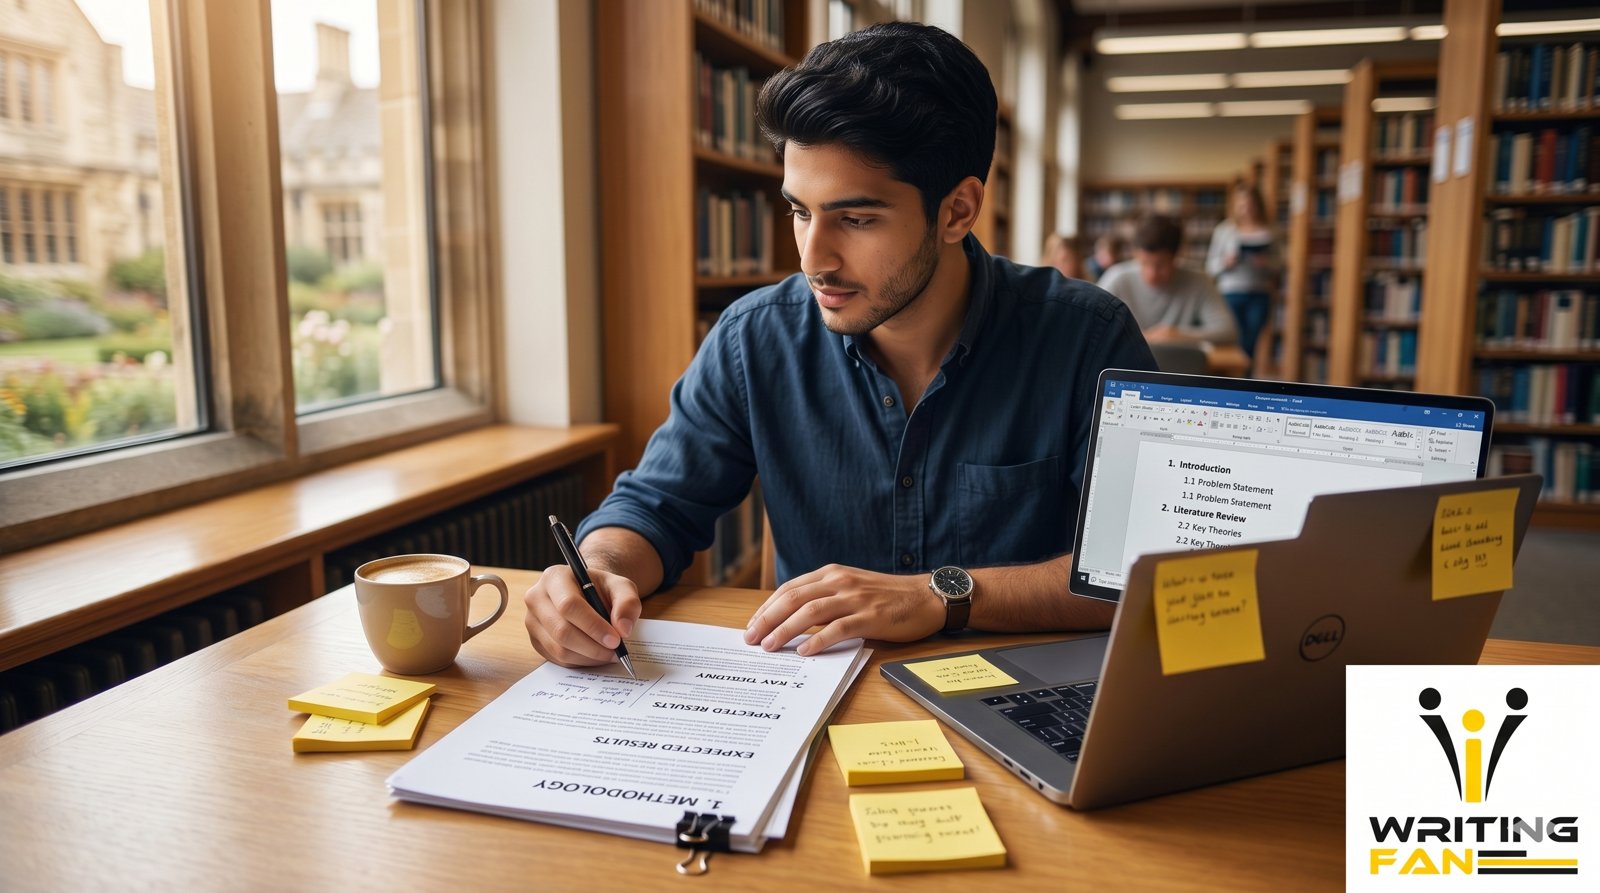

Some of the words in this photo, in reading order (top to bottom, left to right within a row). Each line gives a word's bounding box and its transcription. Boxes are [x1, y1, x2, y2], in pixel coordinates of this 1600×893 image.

[1168, 460, 1176, 468] 1.
[1180, 460, 1231, 474] Introduction
[1184, 476, 1196, 485] 1.1
[1198, 478, 1231, 490] Problem
[1232, 483, 1274, 495] Statement
[1182, 492, 1194, 500] 1.1
[1196, 493, 1229, 504] Problem
[1162, 504, 1170, 512] 2.
[1174, 506, 1214, 518] Literature
[1216, 512, 1246, 523] Review
[1178, 522, 1190, 530] 2.2
[1192, 524, 1206, 534] Key
[1208, 526, 1242, 538] Theories
[1176, 536, 1188, 544] 2.2
[1190, 538, 1204, 549] Key
[652, 701, 709, 712] RESULTS
[712, 708, 781, 720] EXPECTED
[593, 736, 658, 750] RESULTS
[660, 743, 755, 758] EXPEECTED
[533, 780, 699, 807] METHODOLOGY
[708, 800, 724, 810] 1.
